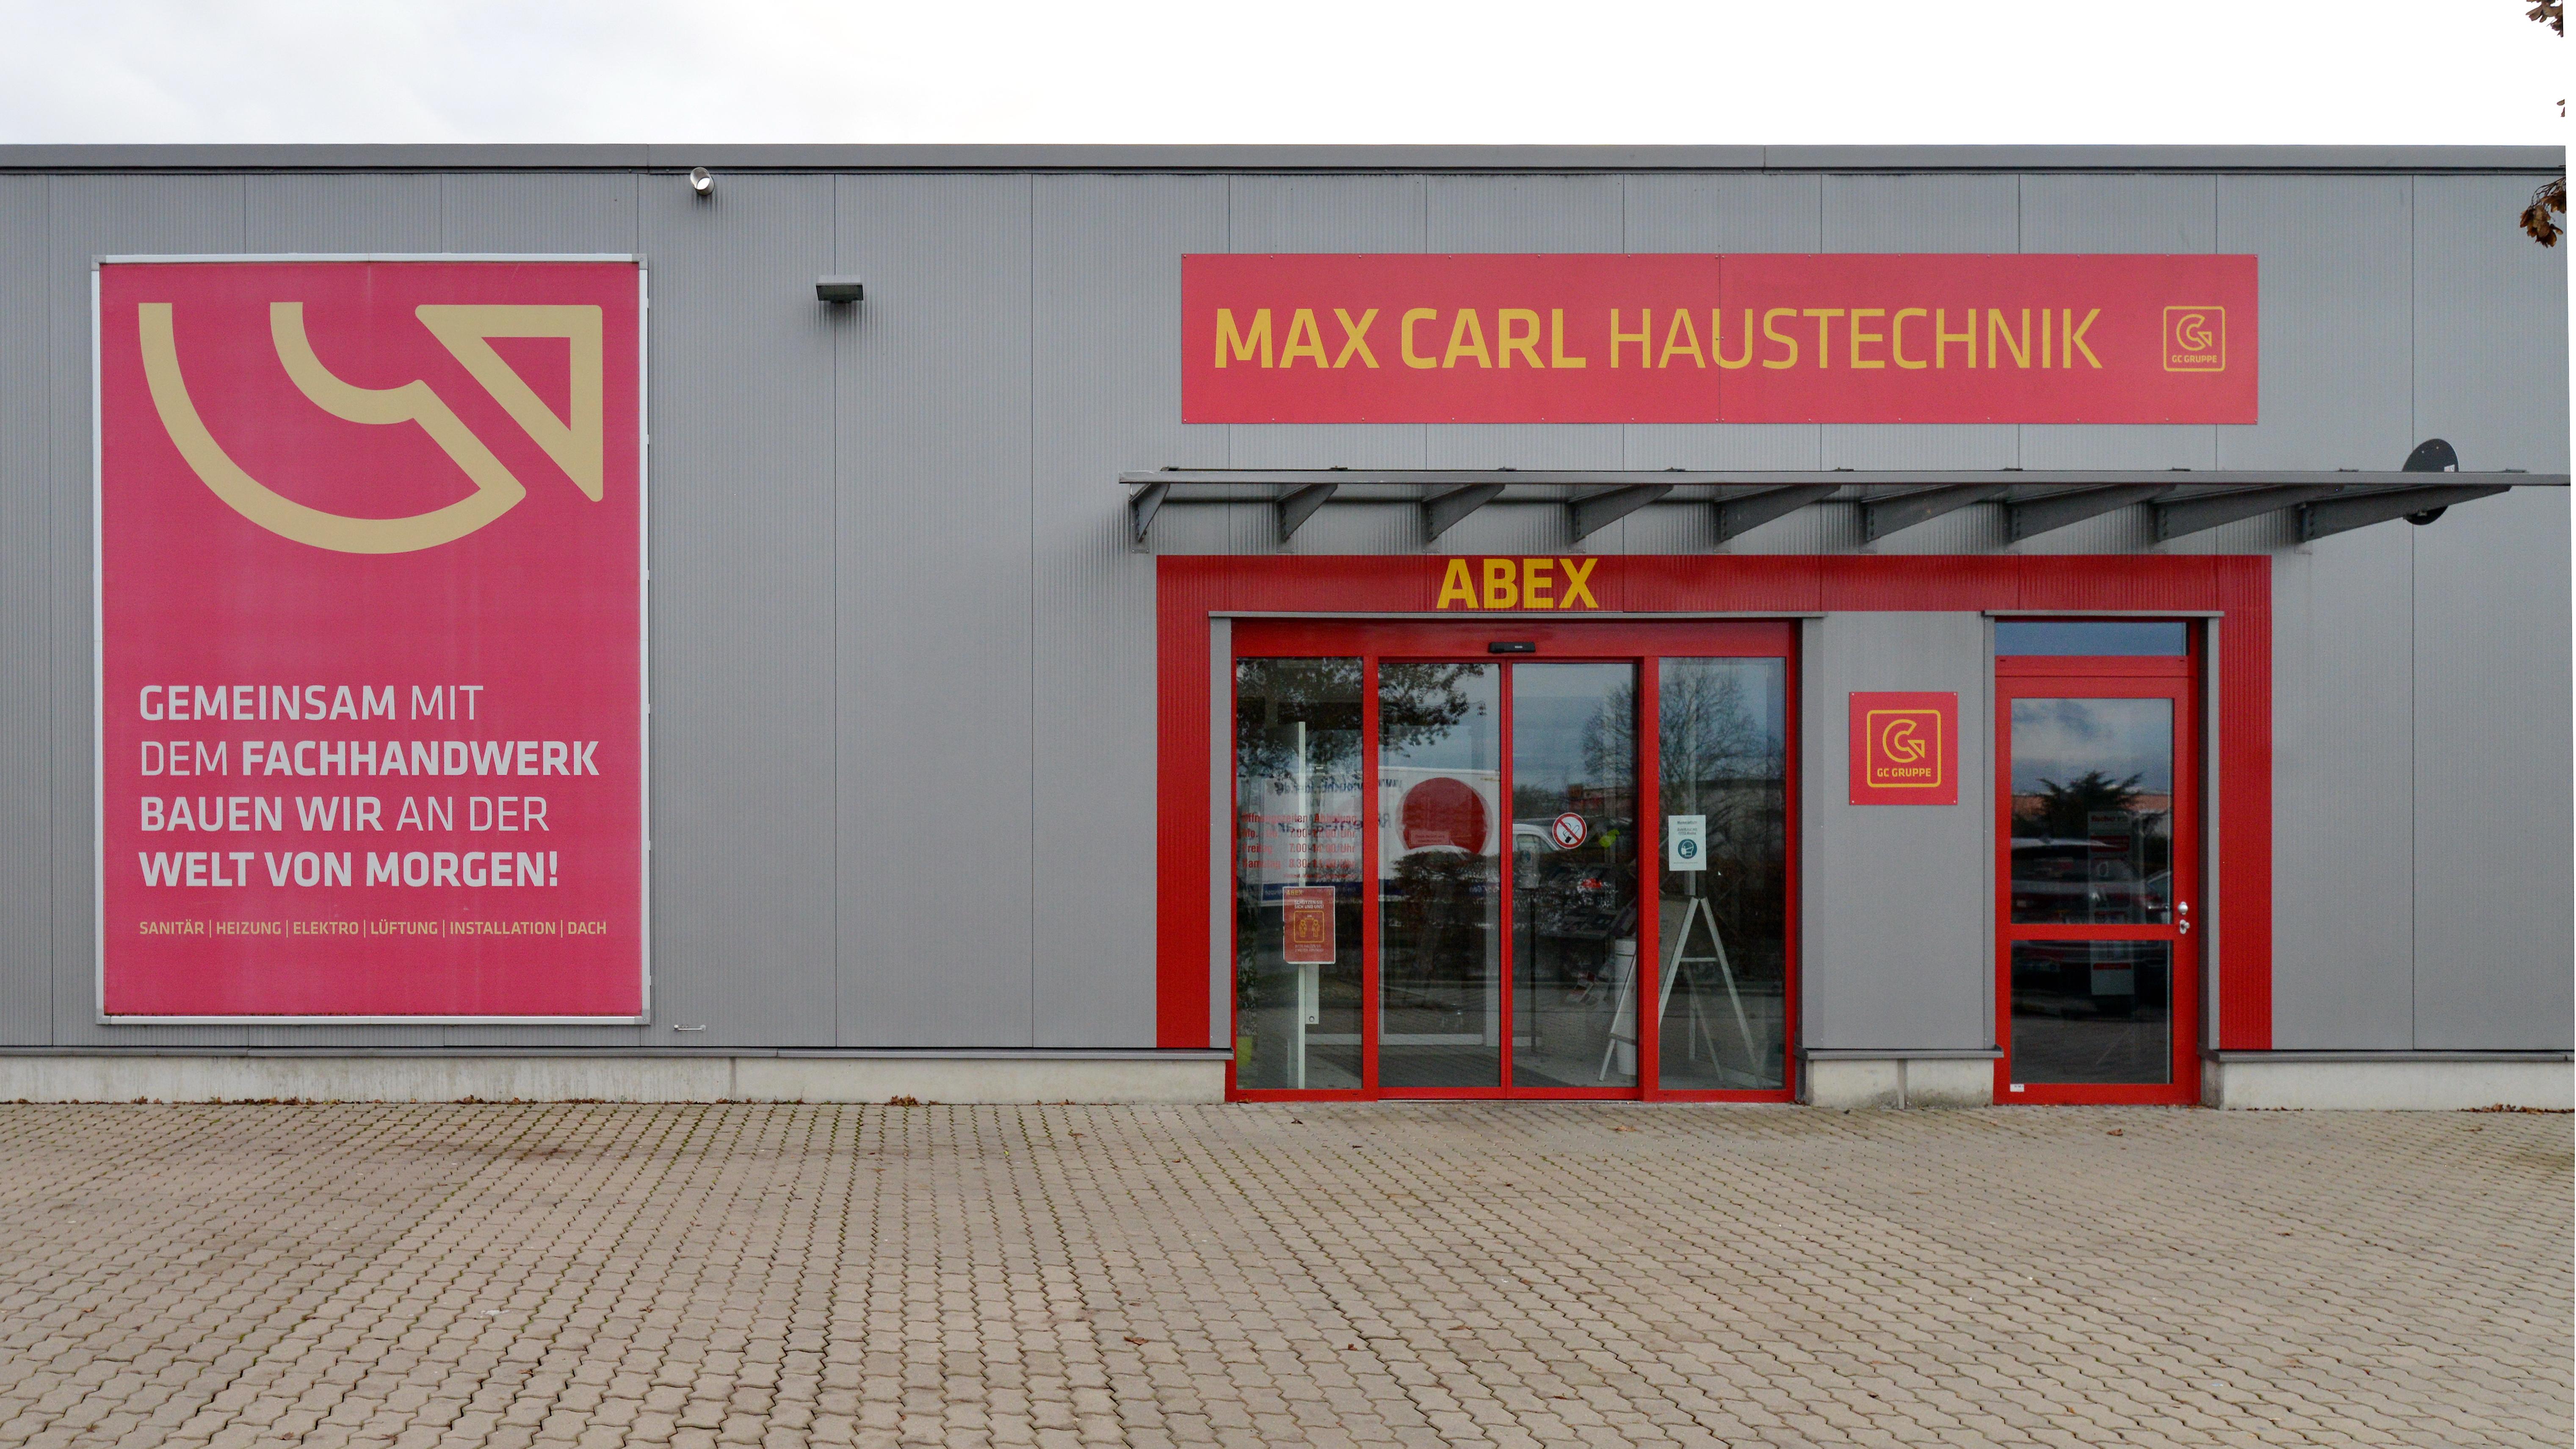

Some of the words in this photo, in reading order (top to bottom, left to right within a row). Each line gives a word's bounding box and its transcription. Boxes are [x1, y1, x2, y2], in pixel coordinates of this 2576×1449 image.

[1216, 308, 1379, 368] MAX
[1402, 308, 1586, 369] CARL
[1611, 308, 2102, 369] HAUSTECHNIK
[2172, 355, 2182, 363] GC
[2184, 355, 2217, 363] GRUPPE
[1437, 559, 1598, 608] ABEX
[140, 685, 395, 721] GEMEINSAM
[412, 686, 484, 720] MIT
[141, 741, 227, 776] DEM
[243, 741, 599, 776] FACHHANDWERK
[1877, 768, 1889, 777] GC
[1892, 768, 1931, 777] GRUPPE
[141, 796, 282, 831] BAUEN
[296, 796, 383, 831] WIR
[396, 796, 453, 831] AN
[470, 796, 549, 831] DER
[138, 852, 254, 886] WELT
[264, 852, 351, 887] VON
[366, 851, 557, 887] MORGEN!
[140, 919, 204, 935] SANITÄR
[216, 921, 281, 935] HEIZUNG
[293, 921, 359, 935] ELEKTRO
[371, 919, 438, 935] LÜFTUNG
[450, 921, 556, 935] INSTALLATION
[568, 921, 606, 935] DACH
